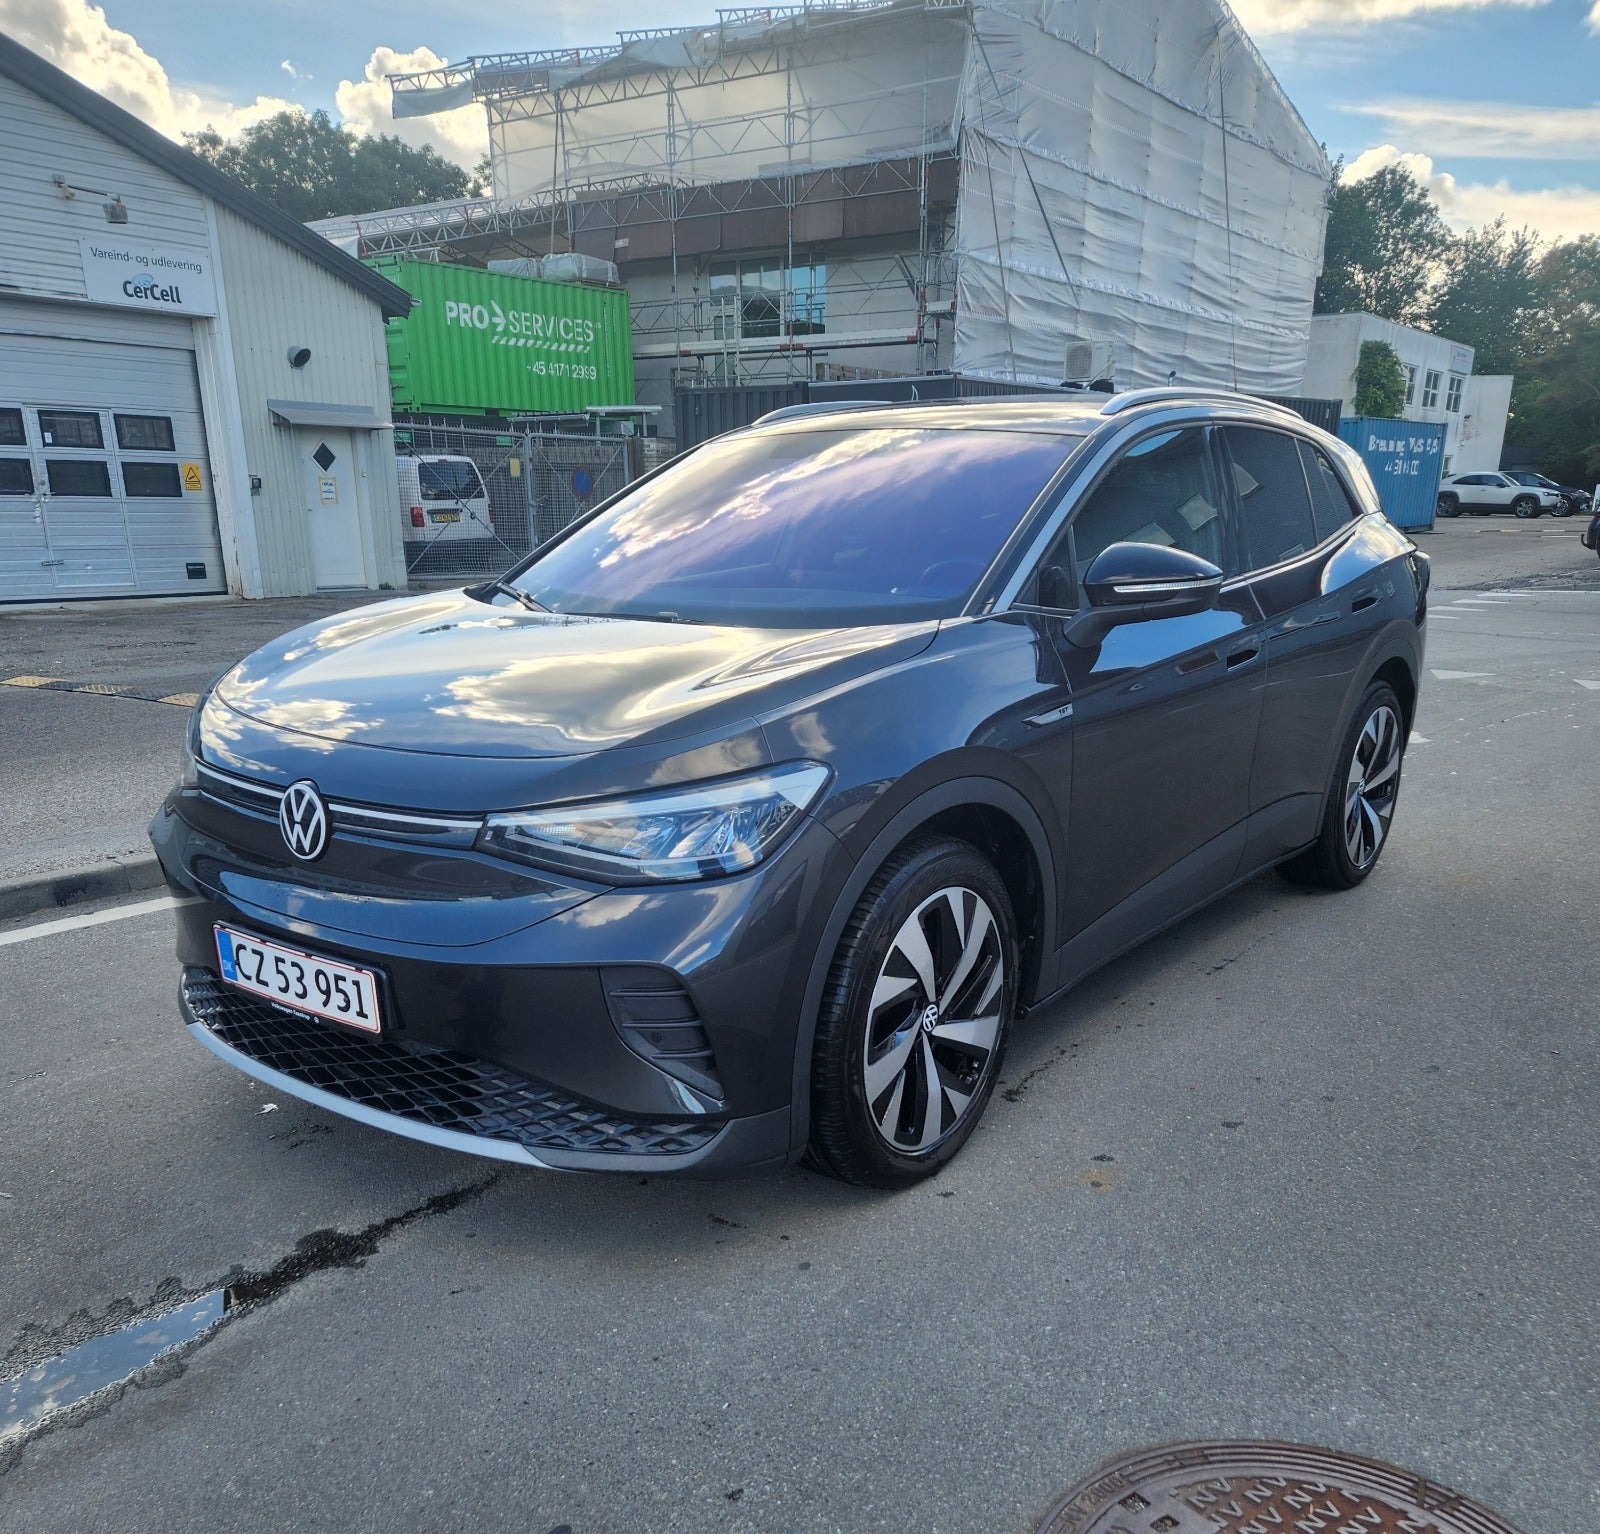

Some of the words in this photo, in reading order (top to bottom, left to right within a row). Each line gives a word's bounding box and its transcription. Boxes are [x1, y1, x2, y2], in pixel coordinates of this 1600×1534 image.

[90, 247, 133, 262] Vareind-
[135, 255, 149, 267] og
[151, 256, 202, 274] udlevering
[122, 280, 182, 304] CerCell
[445, 300, 489, 329] PRO
[508, 310, 594, 342] SERVICES
[548, 363, 570, 377] 4171
[571, 364, 597, 380] 2999
[235, 944, 269, 988] CZ
[274, 955, 308, 1000] 53
[314, 968, 369, 1020] 951
